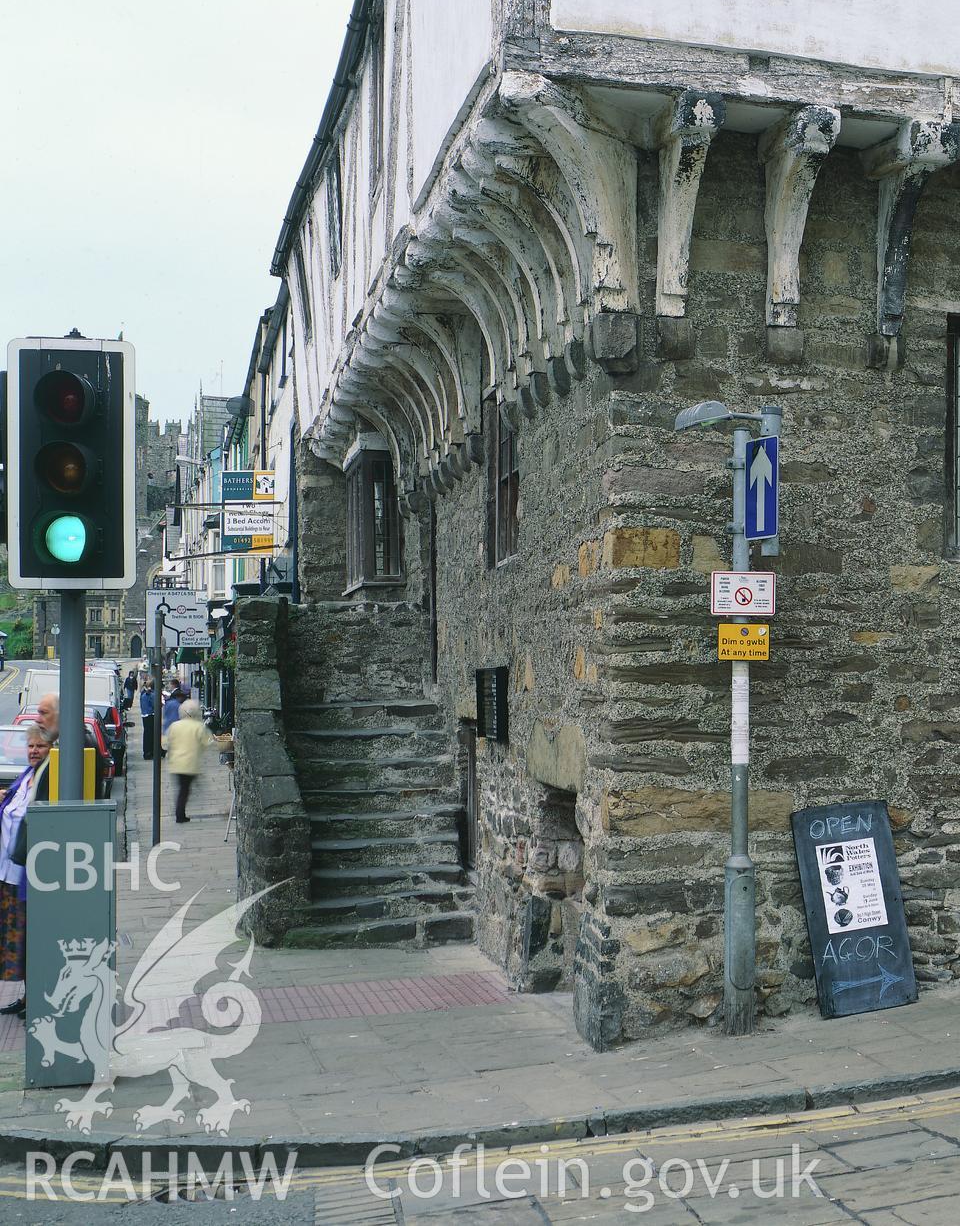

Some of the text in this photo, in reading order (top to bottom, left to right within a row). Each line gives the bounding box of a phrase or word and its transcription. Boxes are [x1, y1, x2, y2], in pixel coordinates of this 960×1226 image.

[747, 638, 766, 646] gwbl
[810, 814, 872, 839] OPEN
[848, 862, 873, 872] EXHIBITION
[858, 915, 882, 924] Conwy
[822, 936, 898, 966] AGOR
